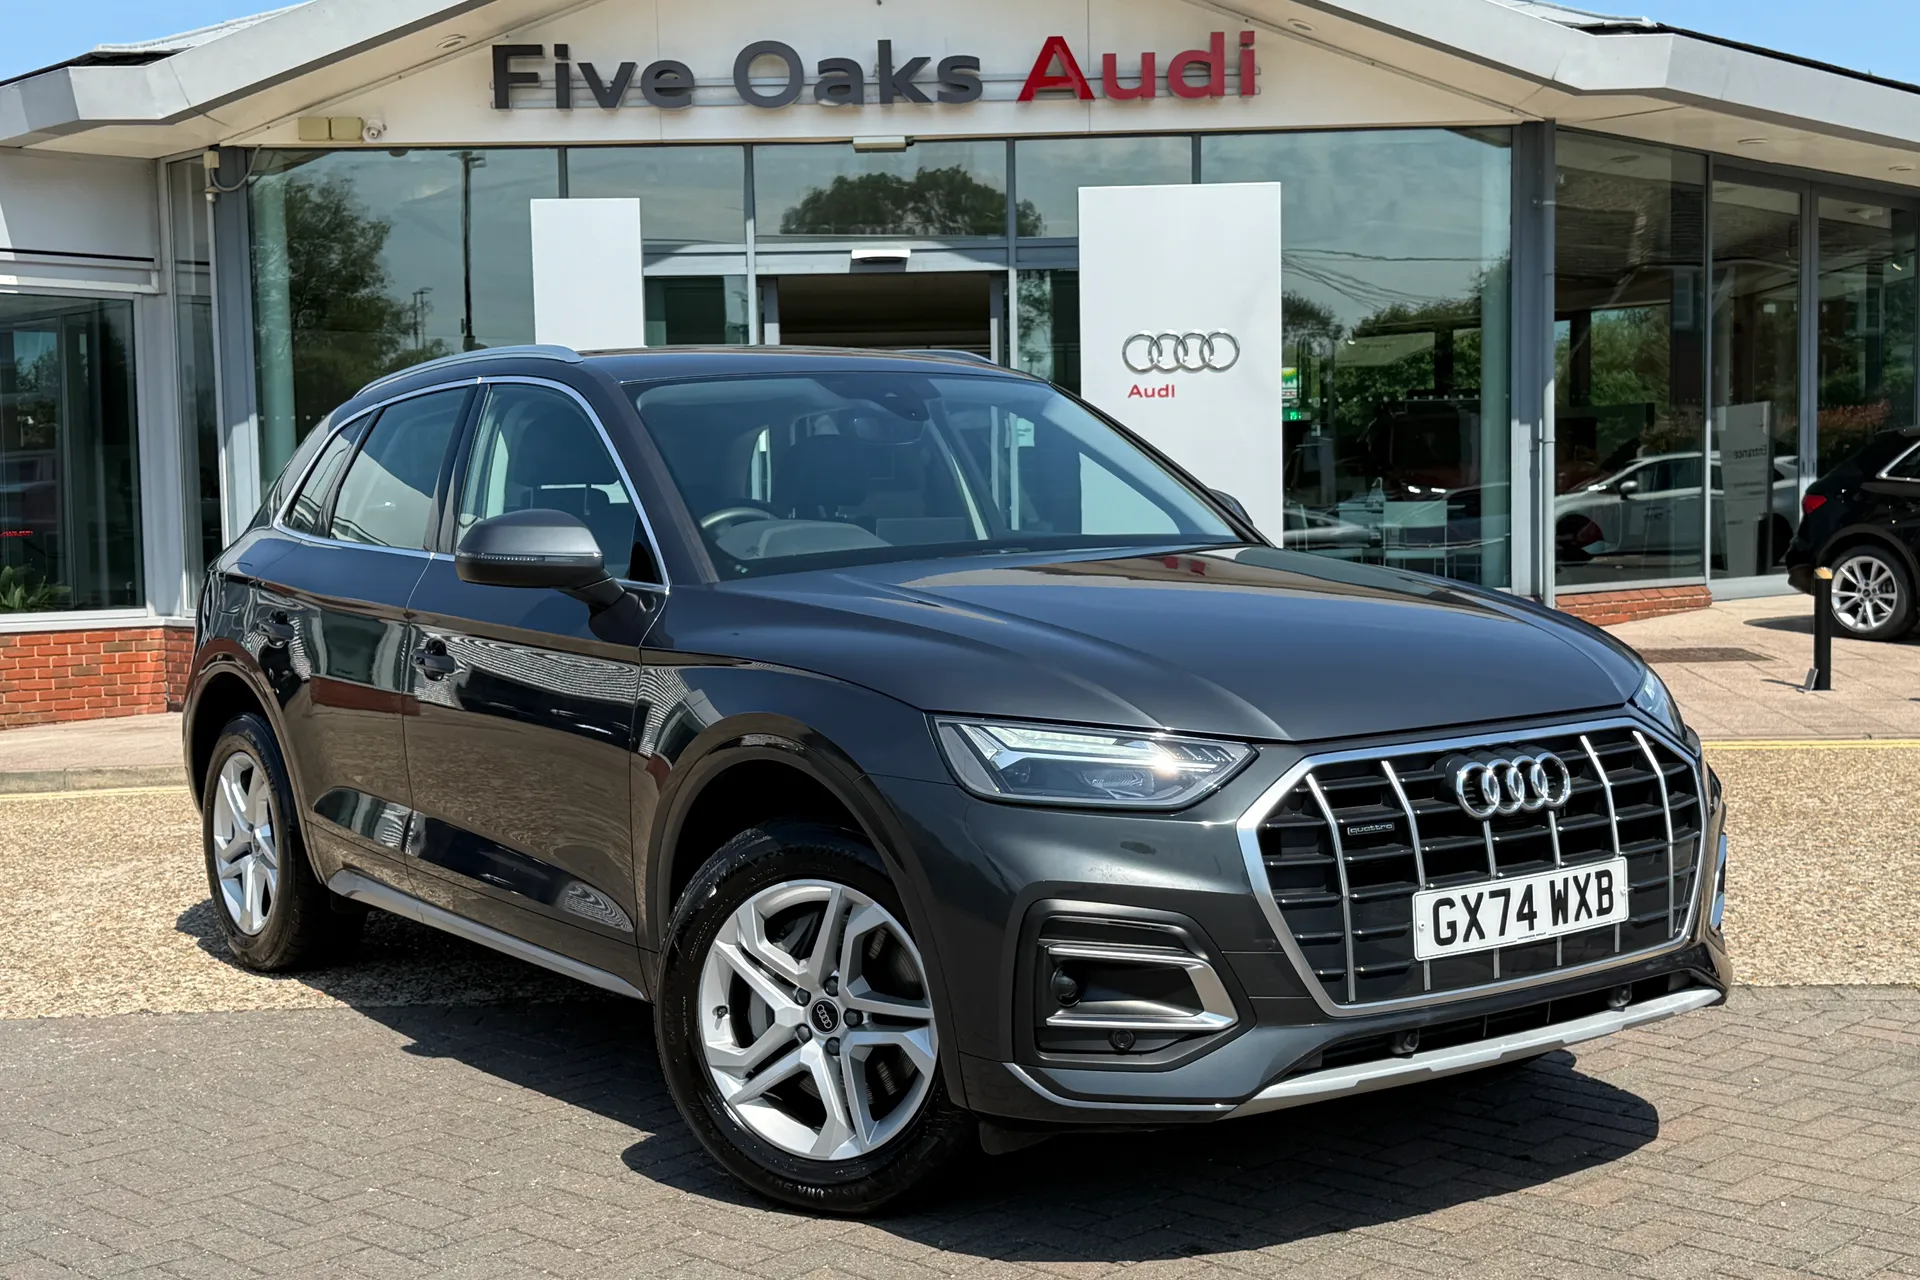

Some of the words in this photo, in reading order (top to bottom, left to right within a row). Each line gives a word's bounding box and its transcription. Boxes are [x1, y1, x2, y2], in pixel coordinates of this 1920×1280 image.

[492, 43, 696, 110] Five
[733, 39, 983, 109] Oaks
[1016, 31, 1256, 103] Audi
[1127, 384, 1176, 398] Audi
[1350, 823, 1393, 834] quattro
[1432, 883, 1538, 947] GX74
[1549, 869, 1614, 927] WXB
